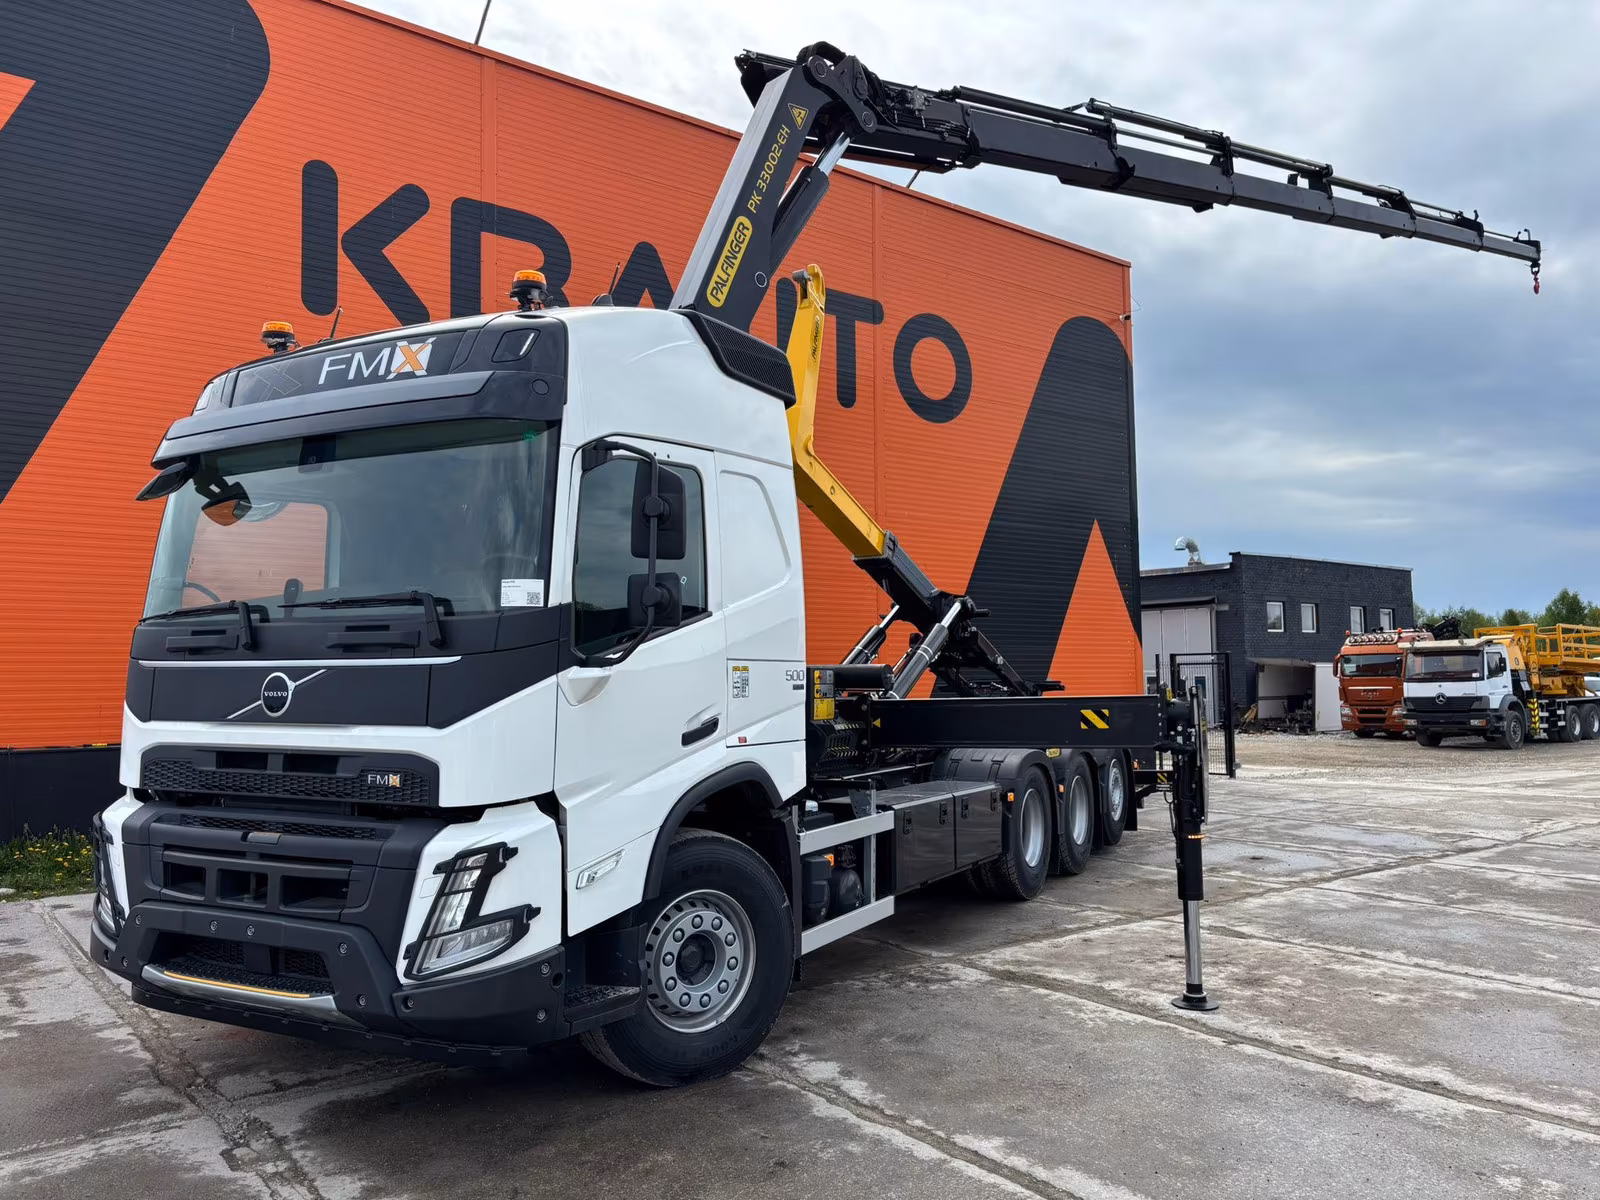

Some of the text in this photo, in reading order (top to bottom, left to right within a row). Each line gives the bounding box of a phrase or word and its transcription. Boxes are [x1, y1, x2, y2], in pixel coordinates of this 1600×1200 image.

[747, 191, 763, 214] PK
[710, 220, 750, 302] PALFINGER
[302, 159, 972, 424] KRTO
[318, 336, 438, 385] FMX
[785, 669, 805, 681] 500
[367, 773, 401, 787] FMX
